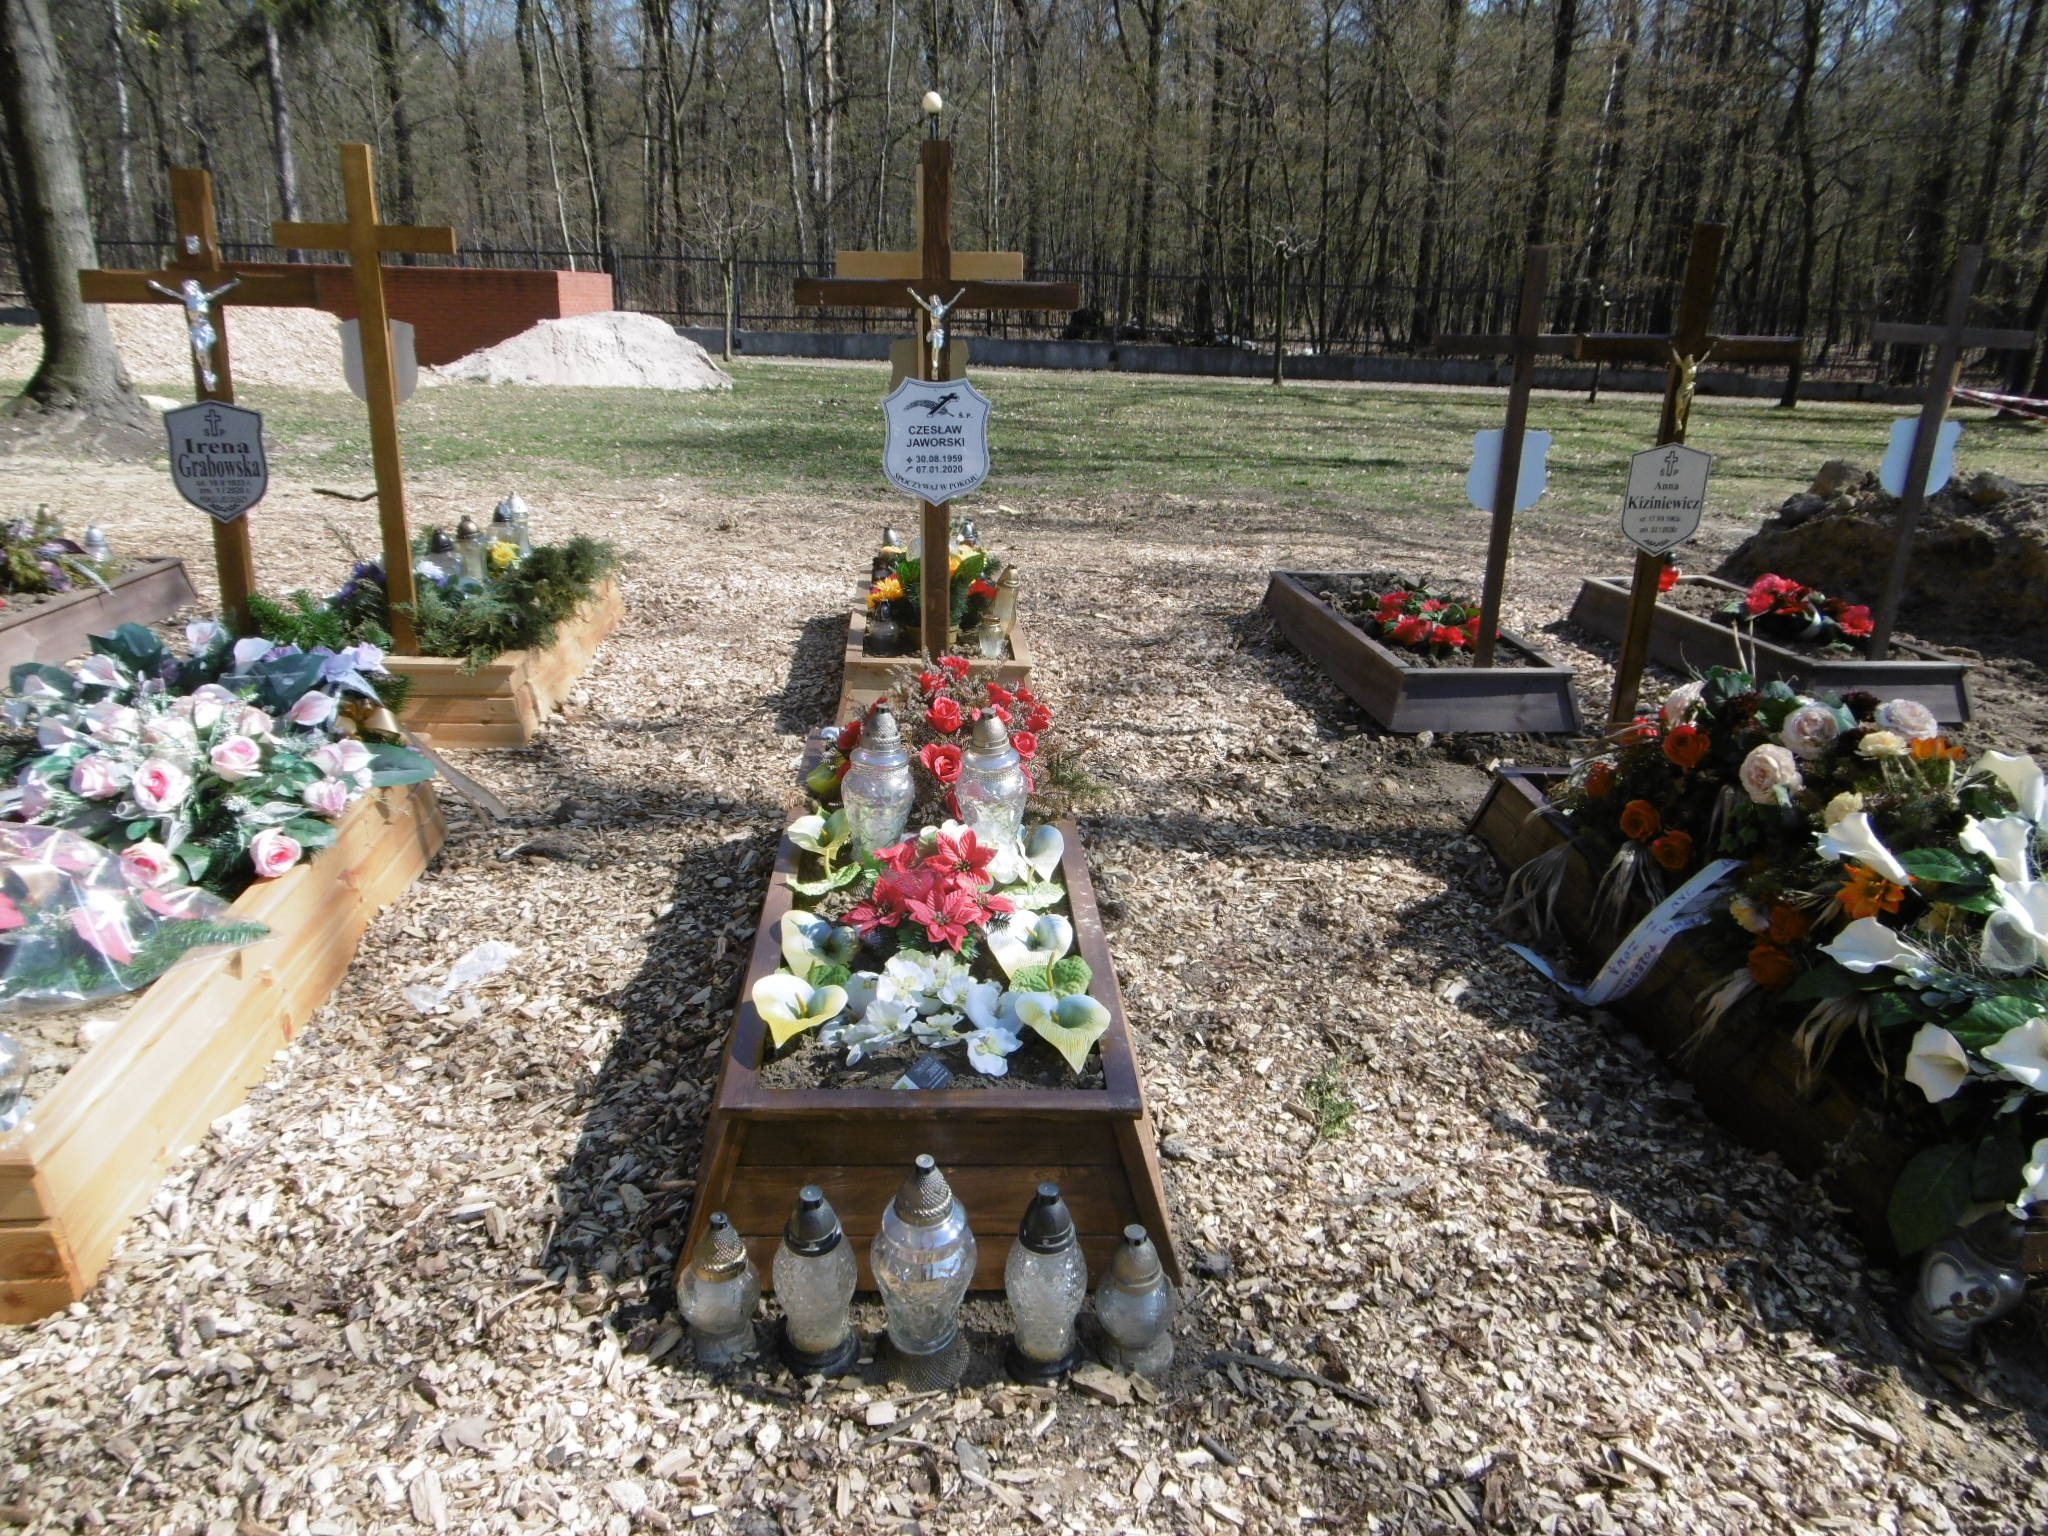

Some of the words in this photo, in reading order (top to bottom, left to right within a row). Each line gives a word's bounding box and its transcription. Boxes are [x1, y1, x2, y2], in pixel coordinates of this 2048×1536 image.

[908, 425, 962, 435] CZESŁAW
[185, 438, 249, 454] Irena
[906, 437, 965, 447] JAWORSKI
[178, 453, 261, 478] Grabowska
[940, 483, 948, 491] W
[1654, 482, 1680, 490] Anna
[1628, 495, 1700, 510] Kiziniewicz
